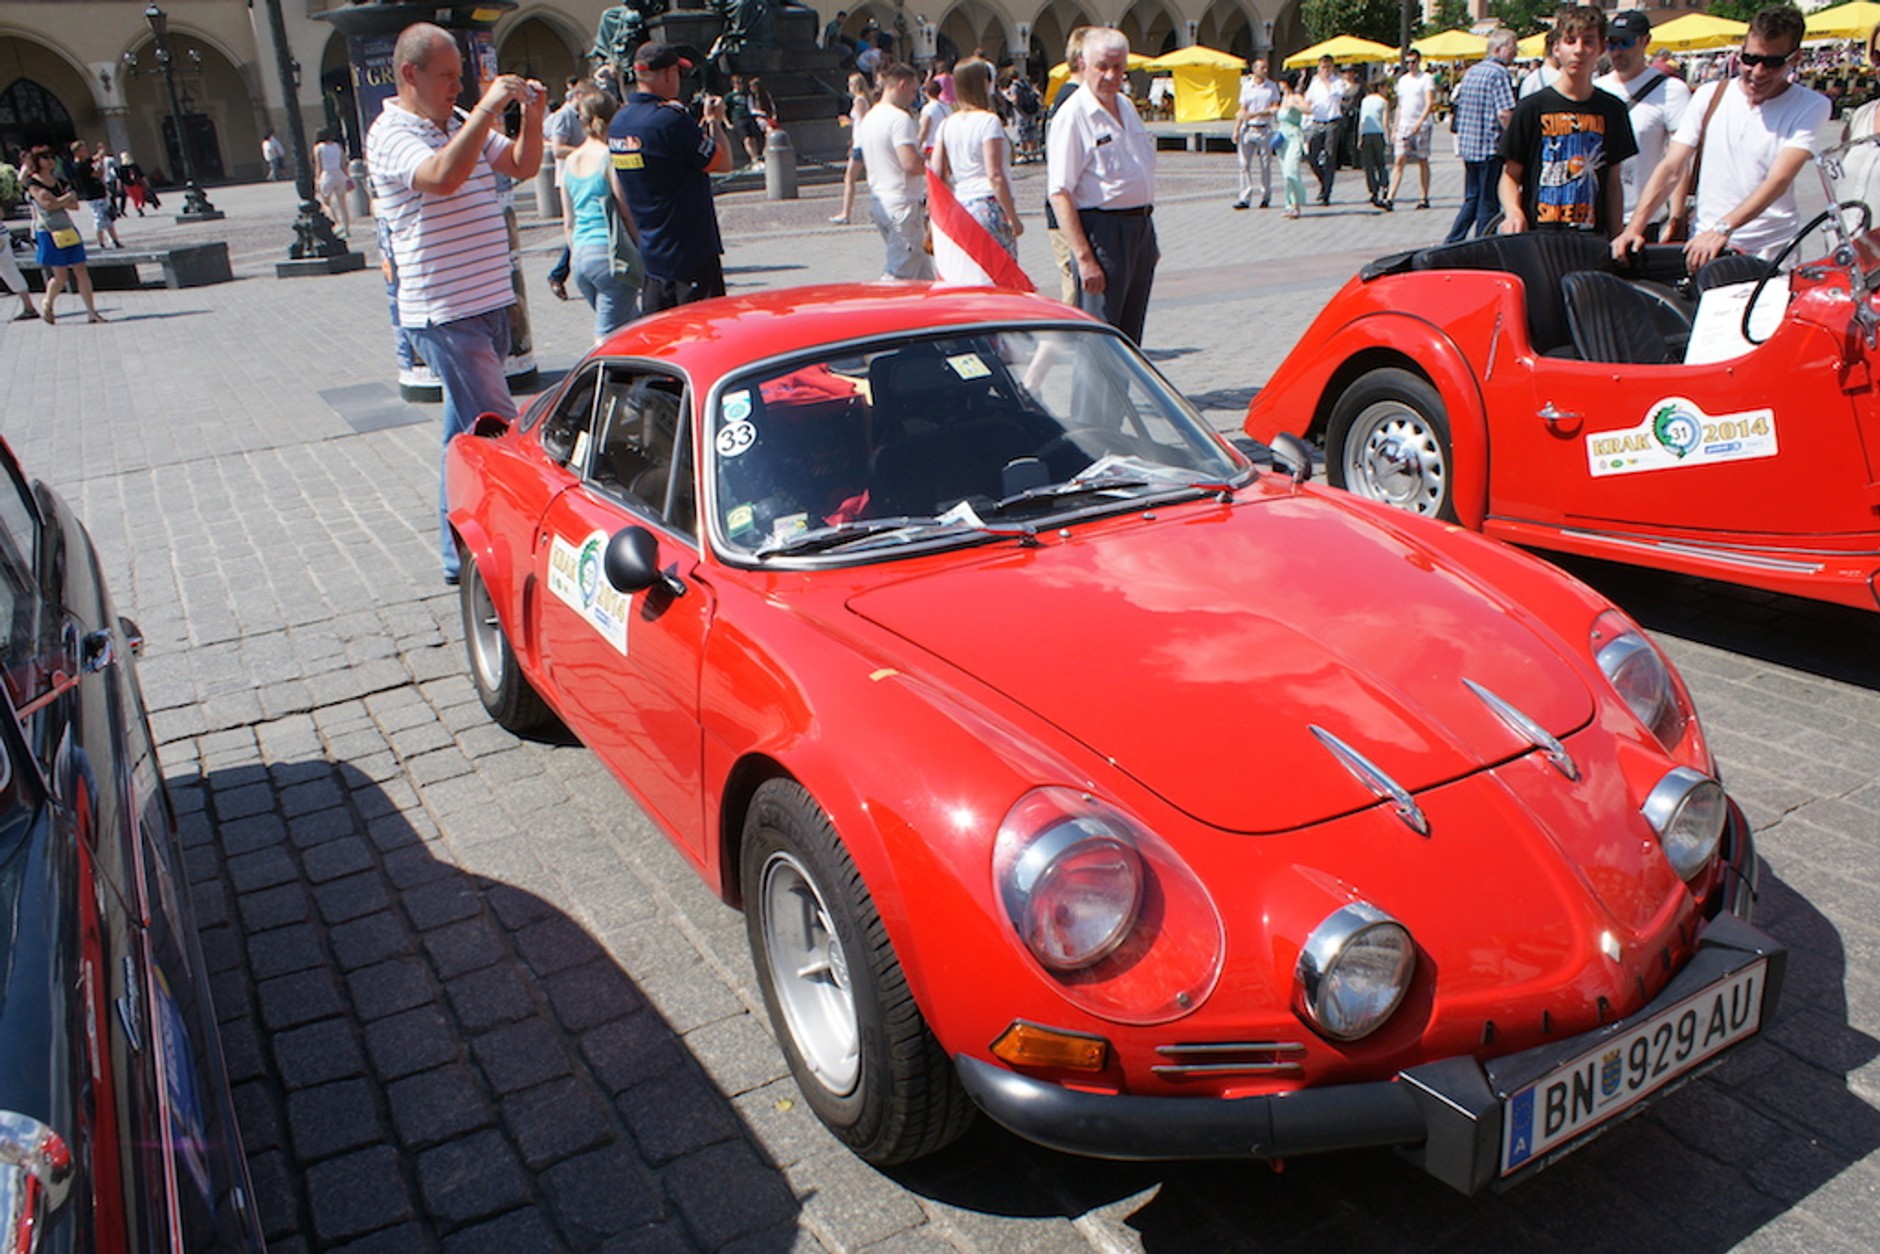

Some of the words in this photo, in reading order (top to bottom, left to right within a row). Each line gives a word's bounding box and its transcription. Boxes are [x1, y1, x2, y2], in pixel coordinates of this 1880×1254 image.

[1826, 159, 1846, 181] 31
[720, 424, 752, 452] 33
[1592, 434, 1652, 457] KRAK
[1670, 427, 1688, 441] 31
[1702, 416, 1770, 444] 2014
[596, 580, 628, 623] 2014
[1515, 1136, 1526, 1156] A
[1543, 1061, 1596, 1139] BN
[1627, 1009, 1697, 1090] 929
[1703, 978, 1754, 1048] AU
